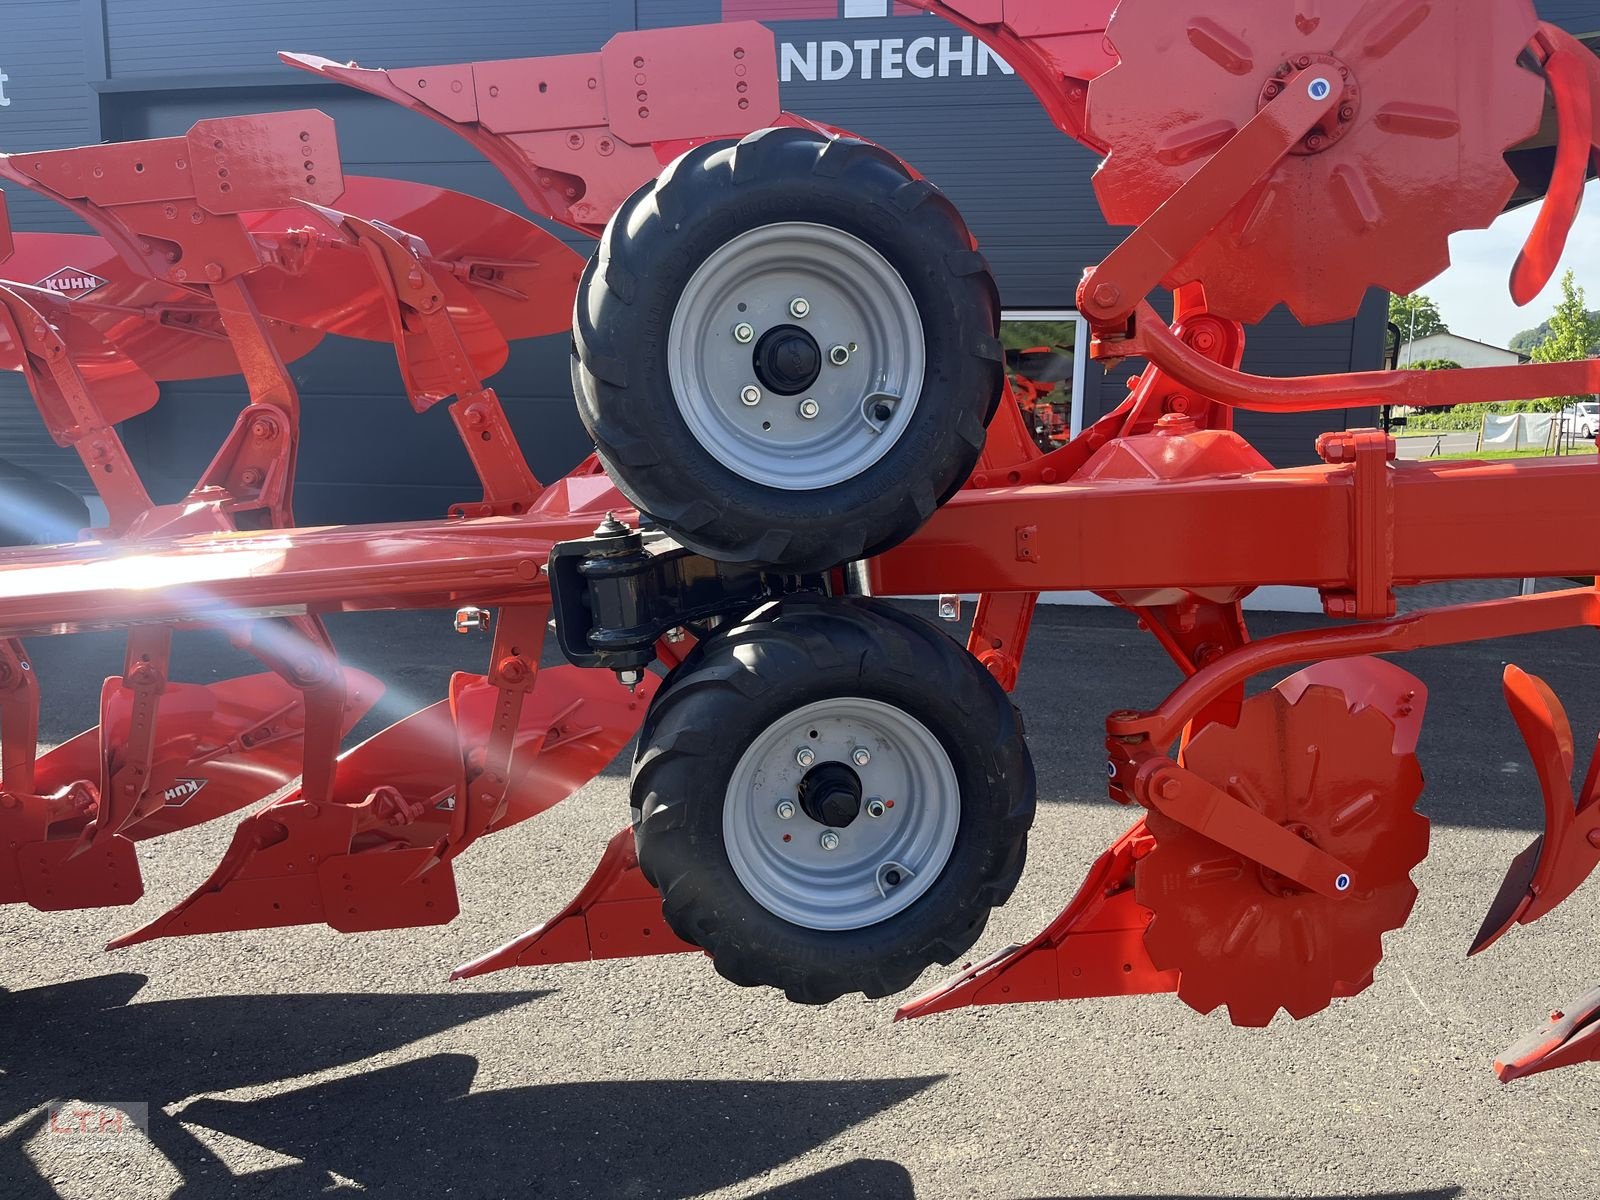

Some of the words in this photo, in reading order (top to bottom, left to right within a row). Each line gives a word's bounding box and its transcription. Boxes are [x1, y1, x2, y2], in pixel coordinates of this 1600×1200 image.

[780, 36, 1015, 82] NDTECHN
[45, 277, 97, 290] KUHN
[164, 780, 199, 801] KUH
